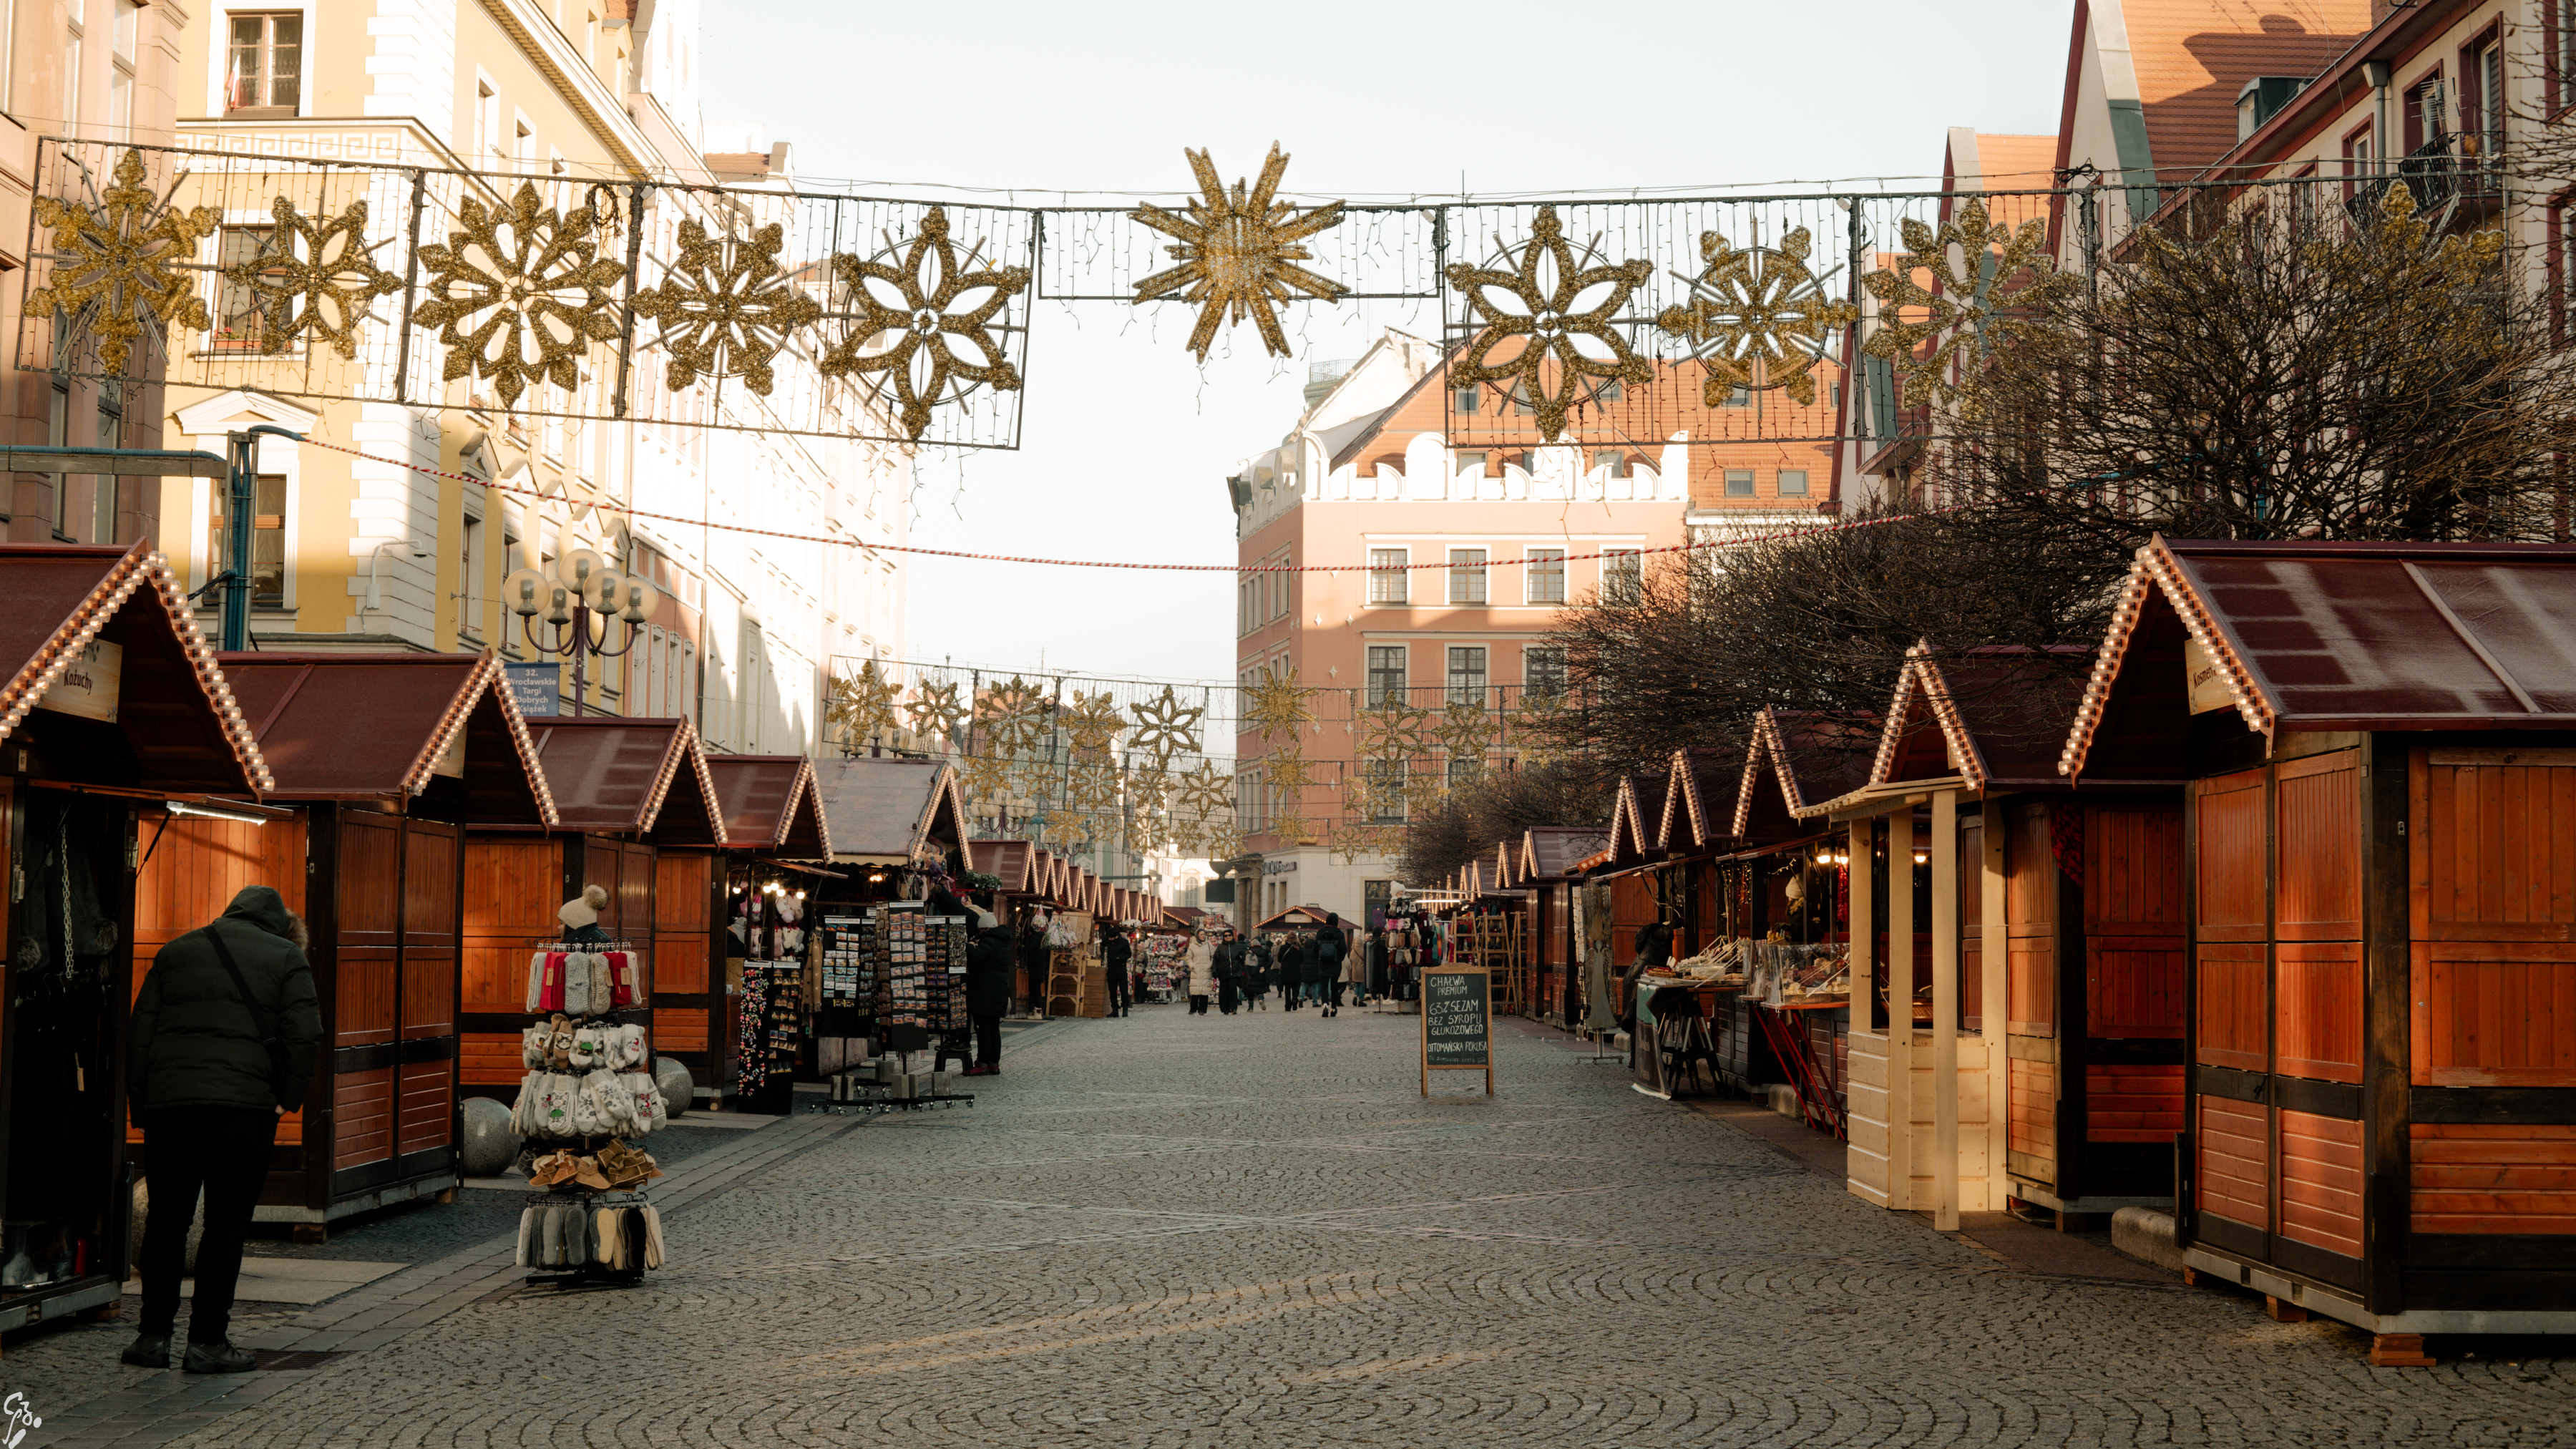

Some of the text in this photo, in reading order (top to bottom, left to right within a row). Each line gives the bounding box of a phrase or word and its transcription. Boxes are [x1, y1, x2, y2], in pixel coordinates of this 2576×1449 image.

[64, 669, 93, 695] Kożuchy
[522, 687, 542, 696] Targi
[517, 696, 548, 705] Dobrych
[519, 705, 547, 714] Książek
[1430, 975, 1465, 987] CHAŁWA
[1438, 985, 1468, 996] PREMIUM
[1429, 999, 1478, 1015] 63% SEZAM
[1428, 1013, 1482, 1026] BEZ SYROPU
[1431, 1024, 1483, 1036] GLUKOZOWEGO
[1427, 1040, 1488, 1053] OTTOMAŃSKA POKUSA
